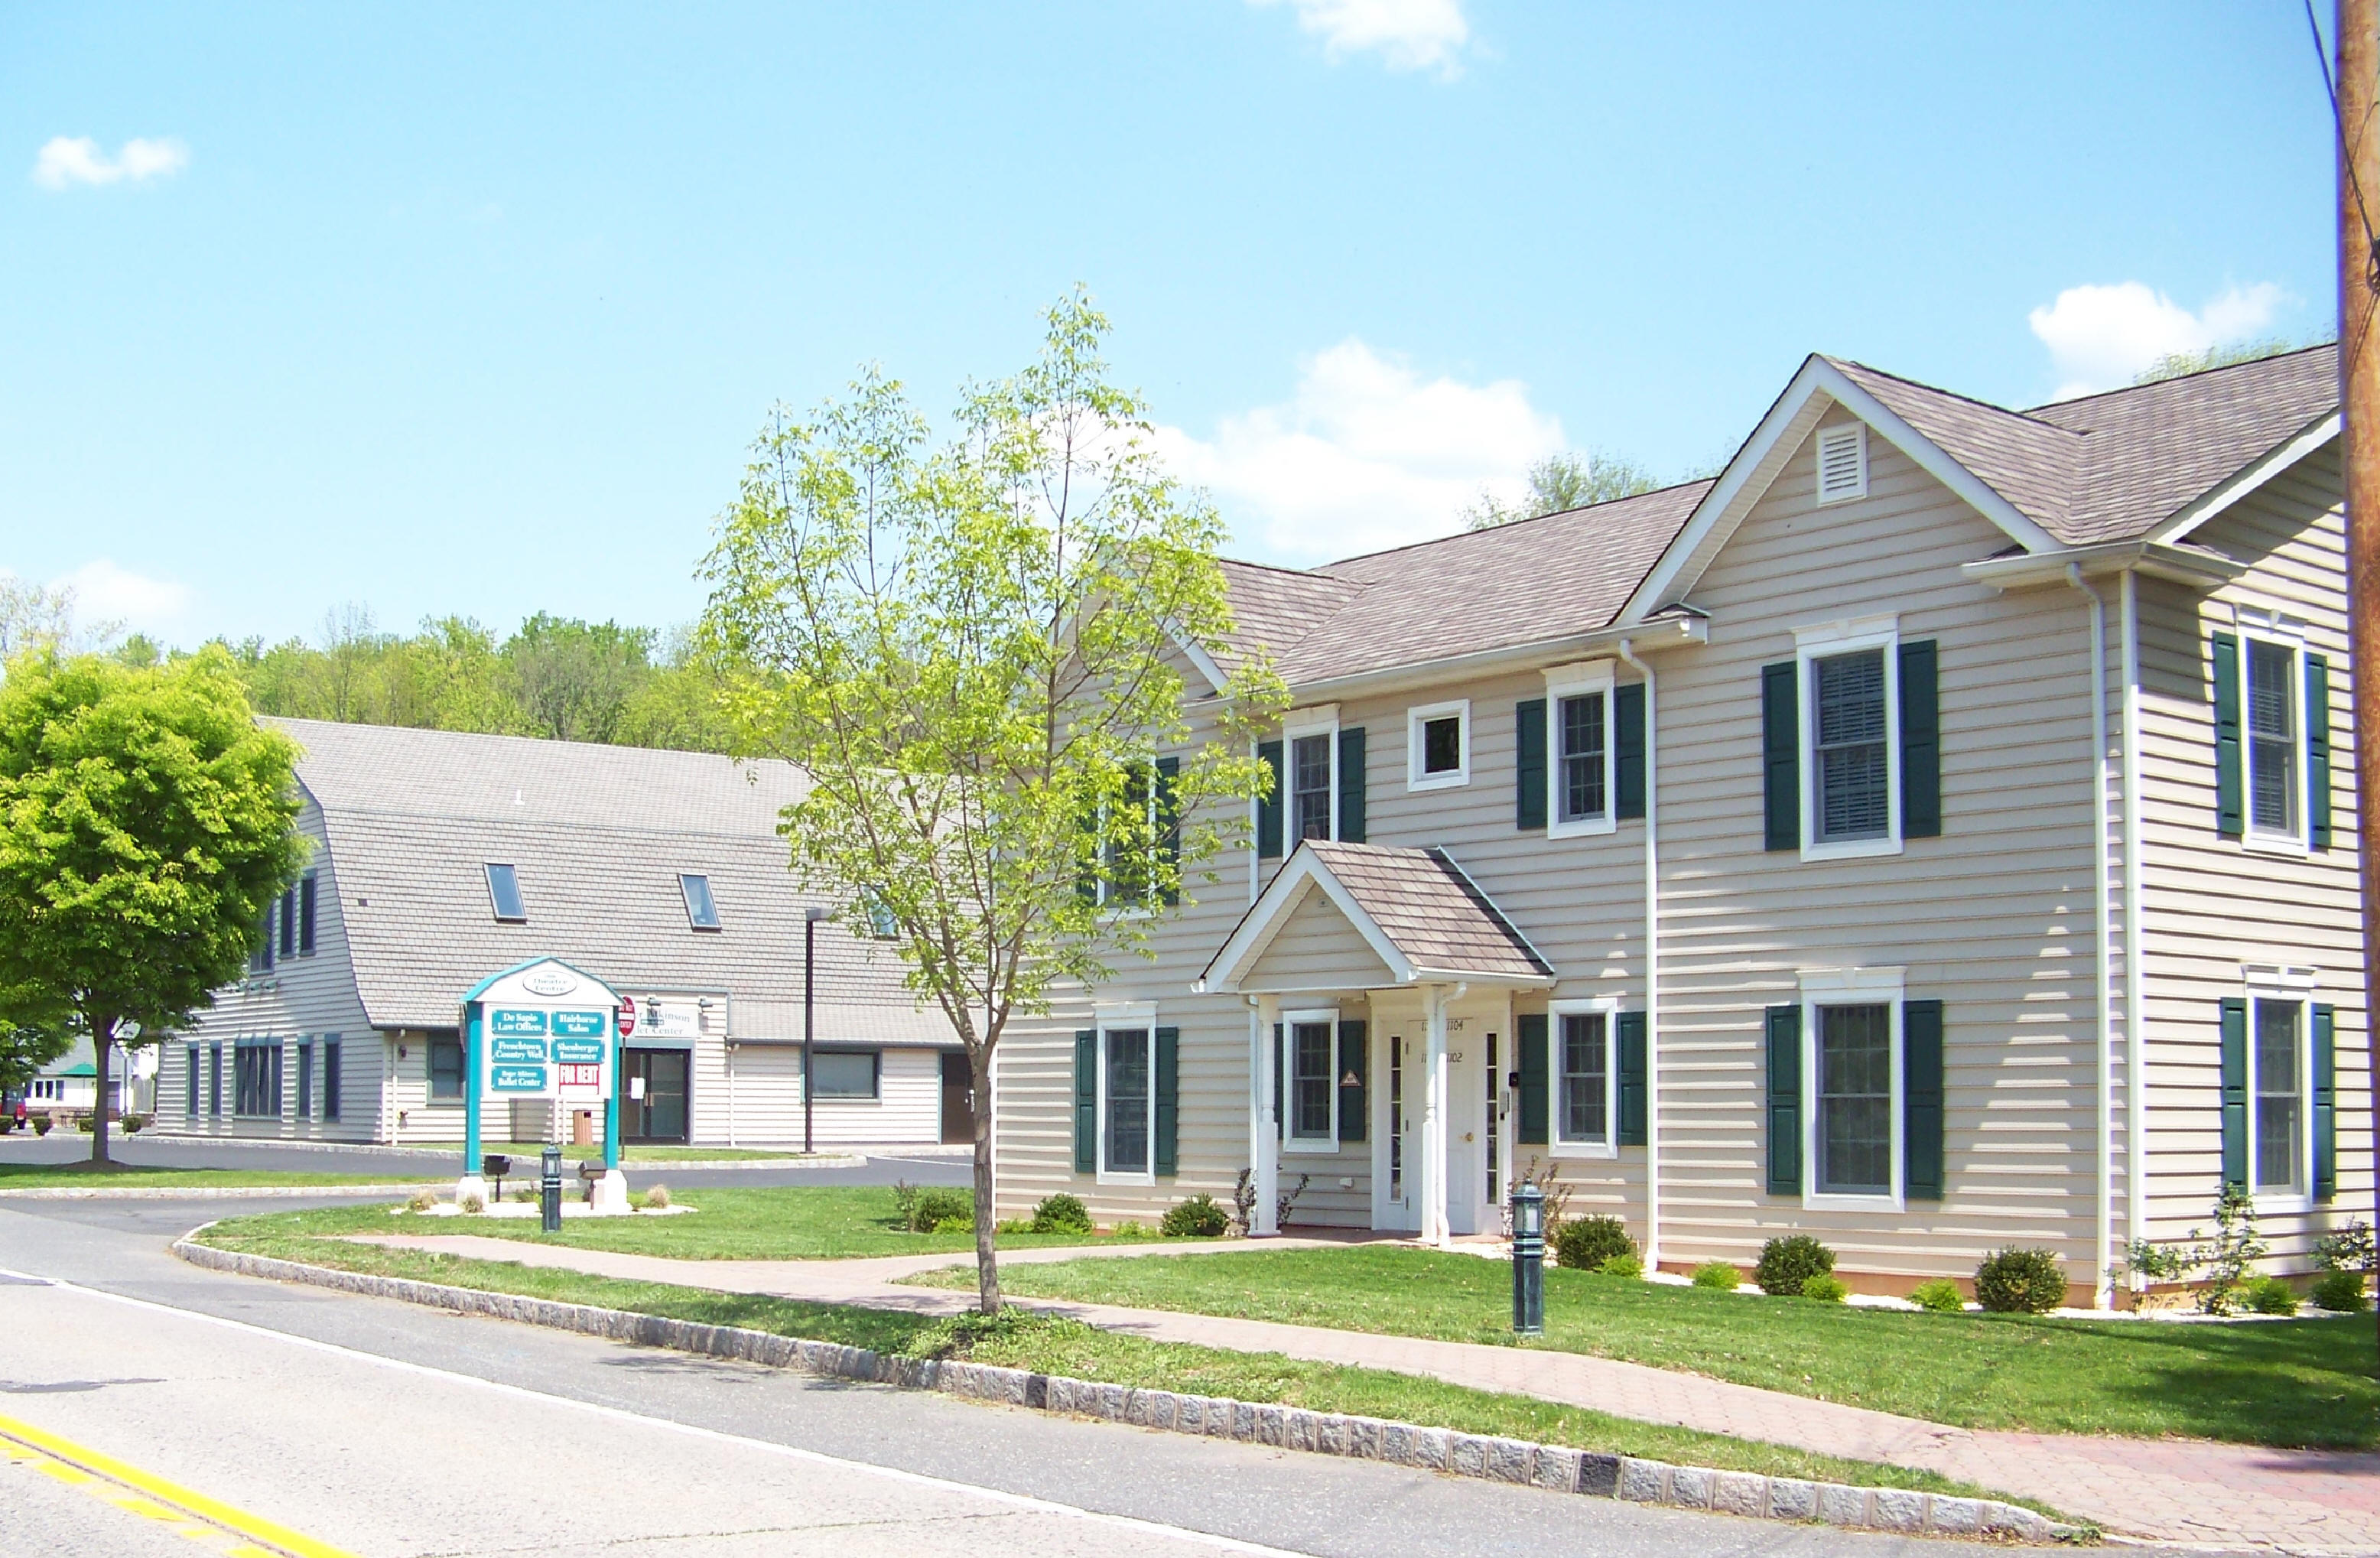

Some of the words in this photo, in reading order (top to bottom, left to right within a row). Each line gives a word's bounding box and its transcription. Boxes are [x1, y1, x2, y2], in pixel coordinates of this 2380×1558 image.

[503, 1013, 515, 1022] De
[497, 1022, 515, 1031] Law
[515, 1022, 543, 1031] Offices
[652, 1026, 684, 1035] Center
[499, 1041, 541, 1050] Frenchtown
[496, 1050, 525, 1061] Country
[526, 1050, 544, 1059] Well
[559, 1052, 597, 1060] Insurance
[559, 1065, 575, 1083] FOR
[576, 1065, 599, 1083] RENT
[498, 1078, 517, 1087] Ballet
[518, 1078, 541, 1087] Center
